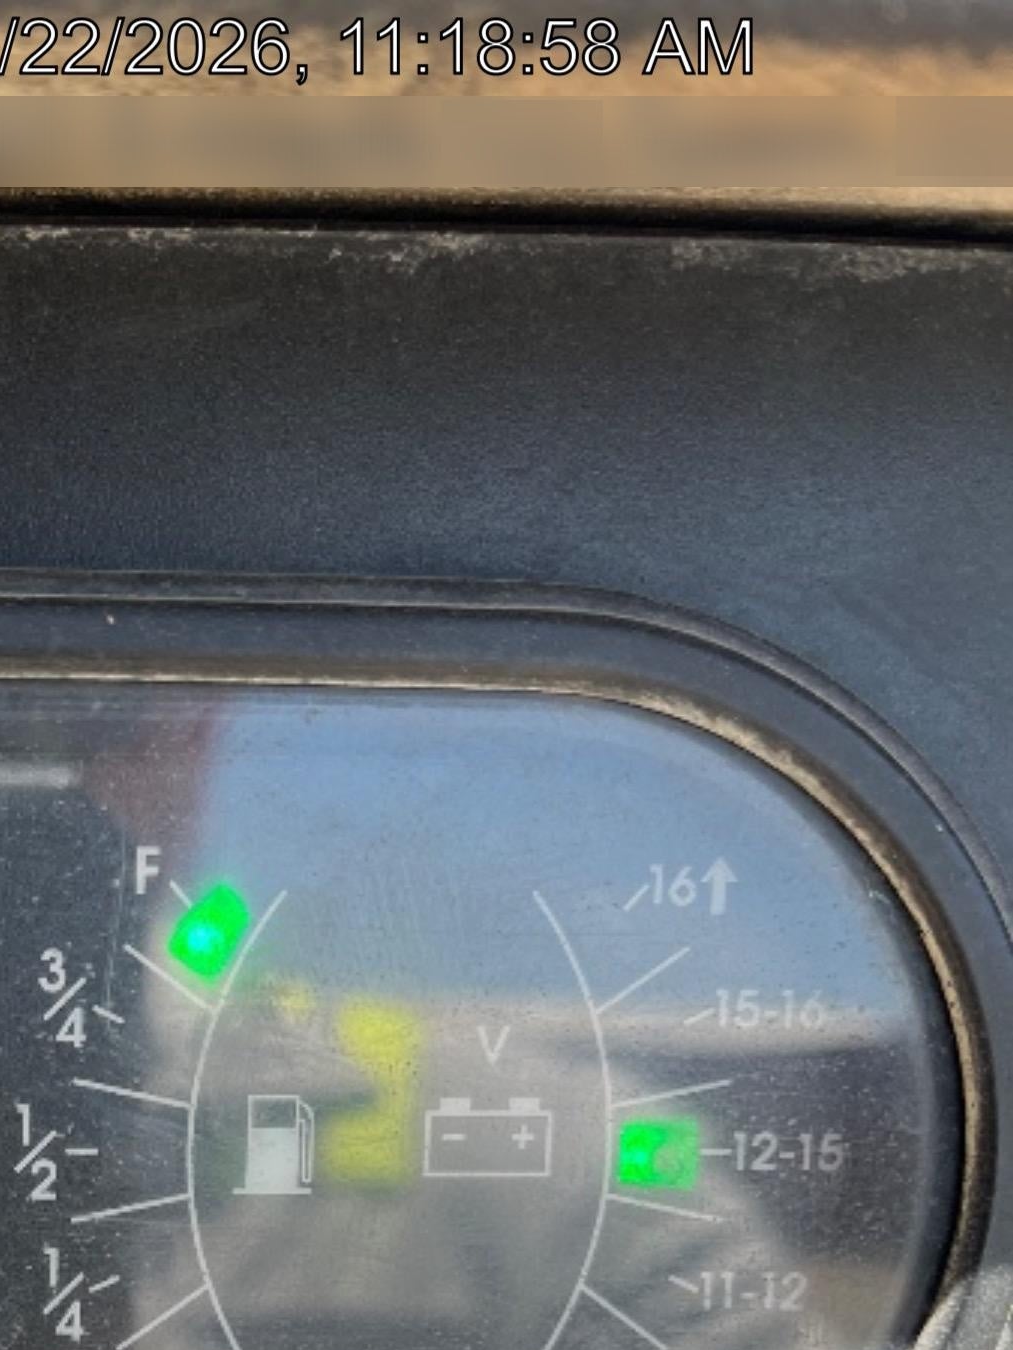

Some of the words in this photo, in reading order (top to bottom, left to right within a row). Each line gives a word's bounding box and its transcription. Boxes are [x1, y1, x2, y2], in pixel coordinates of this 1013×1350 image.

[135, 846, 160, 894] F
[650, 864, 697, 906] 16
[716, 989, 825, 1029] 15-16
[477, 1026, 509, 1064] V
[732, 1132, 843, 1171] 12-15
[700, 1271, 807, 1311] 11-12
